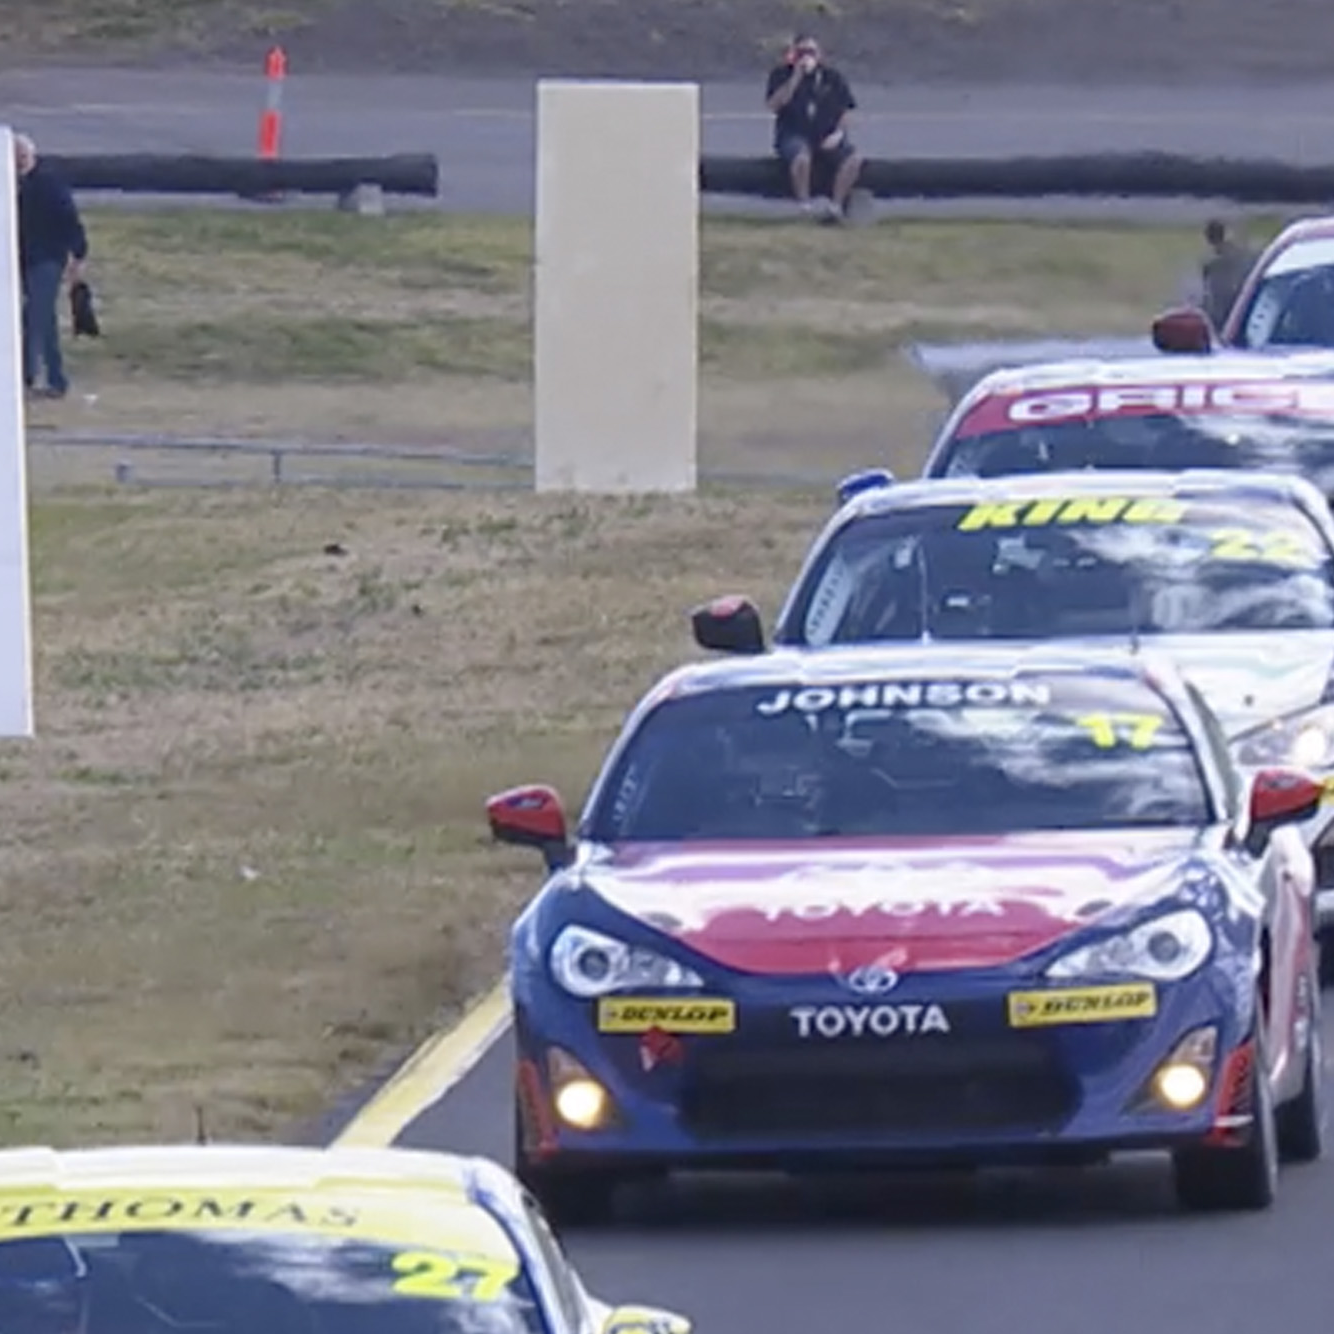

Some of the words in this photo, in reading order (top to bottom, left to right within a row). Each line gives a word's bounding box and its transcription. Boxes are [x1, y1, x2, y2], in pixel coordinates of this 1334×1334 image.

[757, 682, 1050, 714] JOHNSON
[1077, 712, 1164, 750] 17
[620, 1004, 729, 1022] DUNLOP
[1041, 989, 1150, 1016] DUNLOP
[789, 1004, 951, 1038] TOYOTA
[3, 1196, 361, 1228] THOMAS
[390, 1250, 520, 1301] 27
